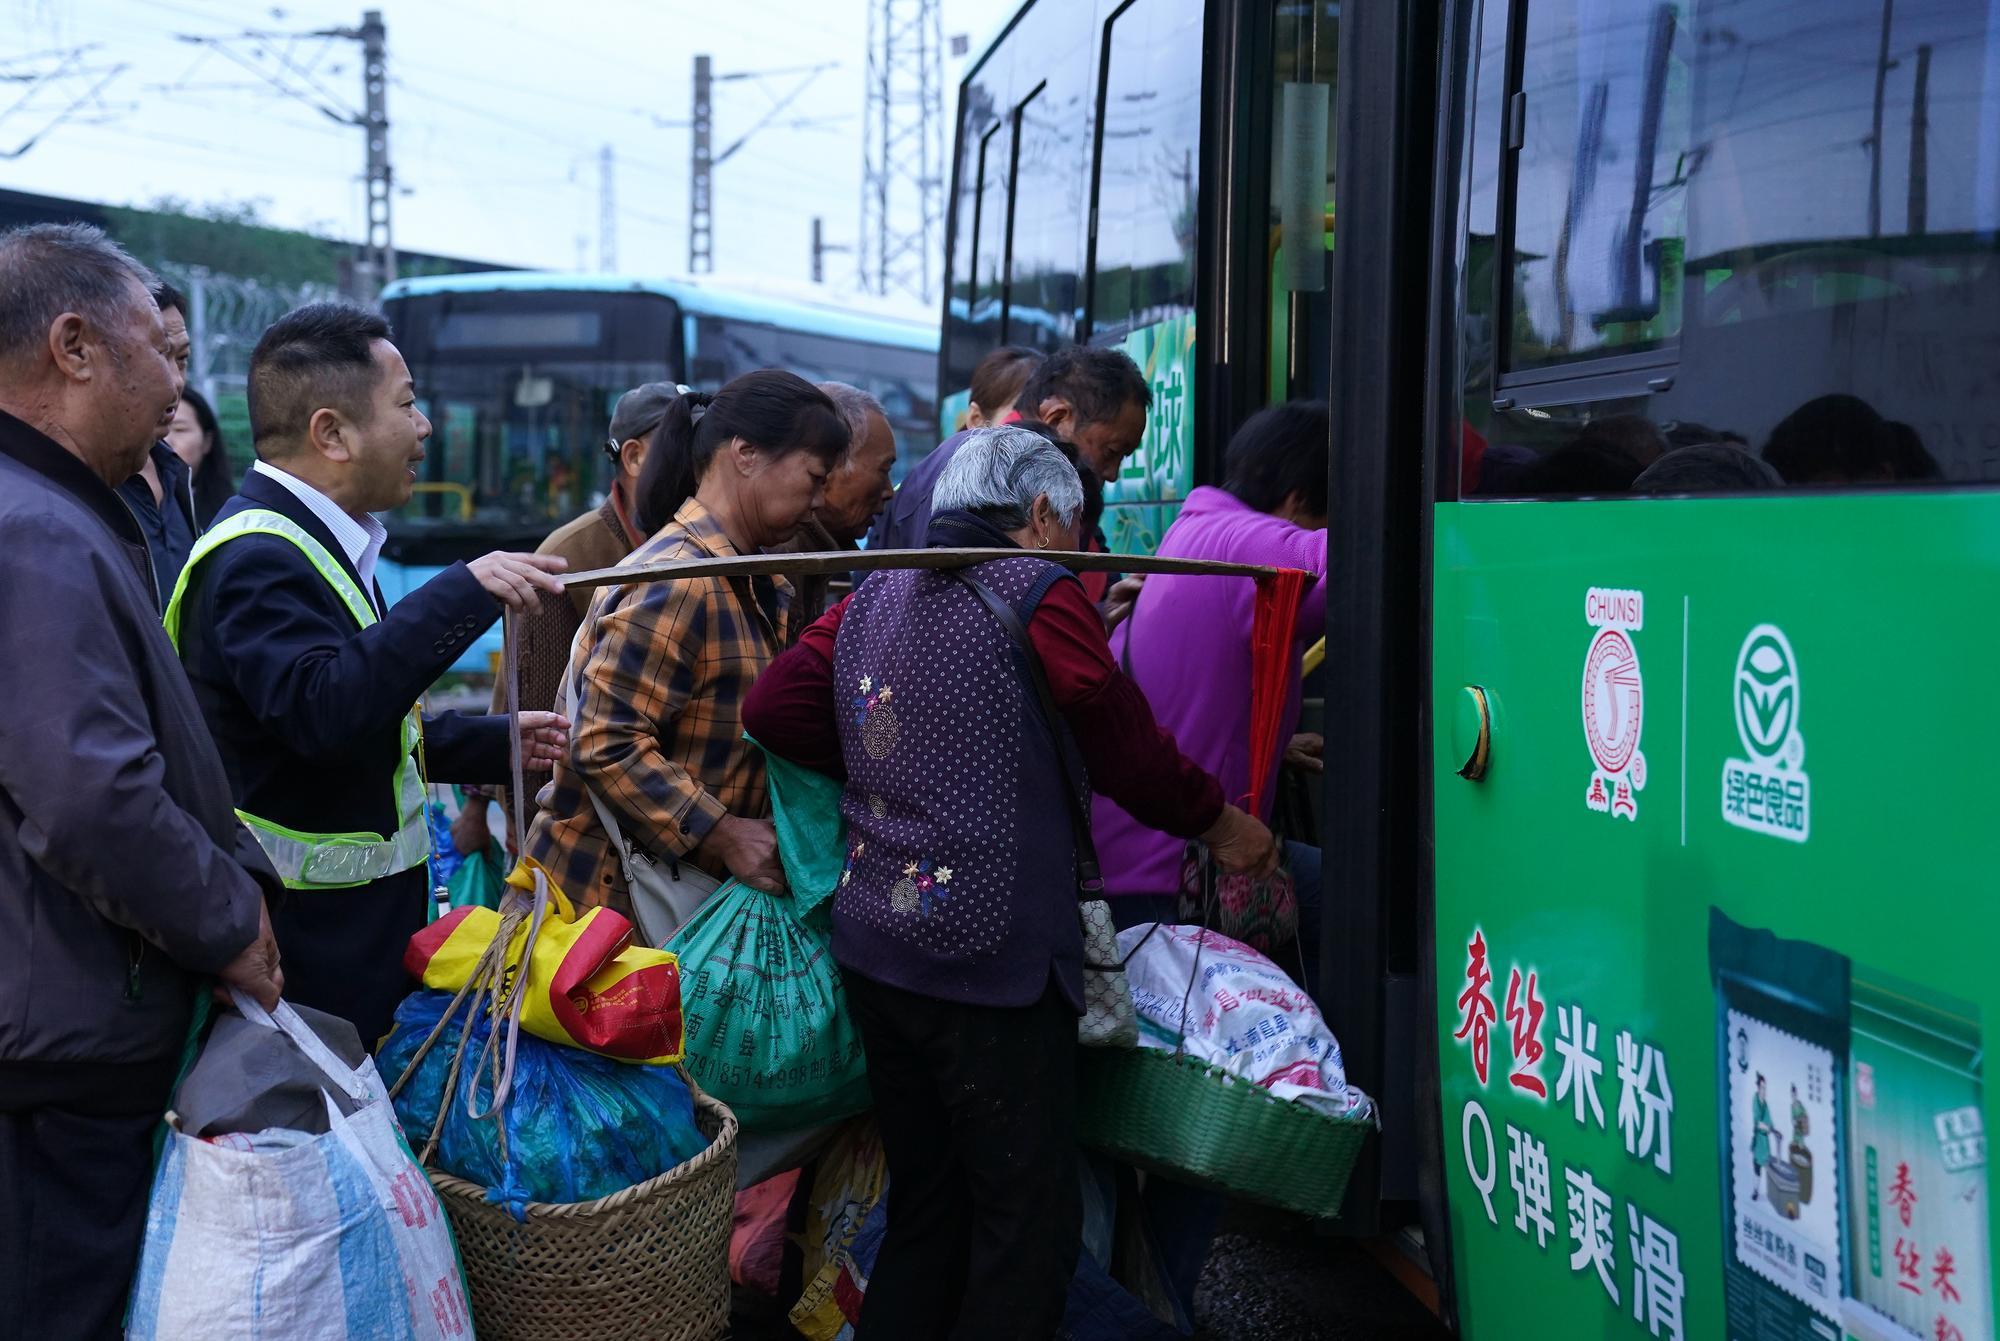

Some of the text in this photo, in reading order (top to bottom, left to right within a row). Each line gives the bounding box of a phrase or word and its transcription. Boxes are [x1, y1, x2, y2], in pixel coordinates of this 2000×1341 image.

[1588, 595, 1640, 623] CHUNSI
[1454, 930, 1674, 1175] 春丝米粉
[1462, 1100, 1686, 1341] Q弹爽滑
[1888, 1161, 1922, 1295] 春丝
